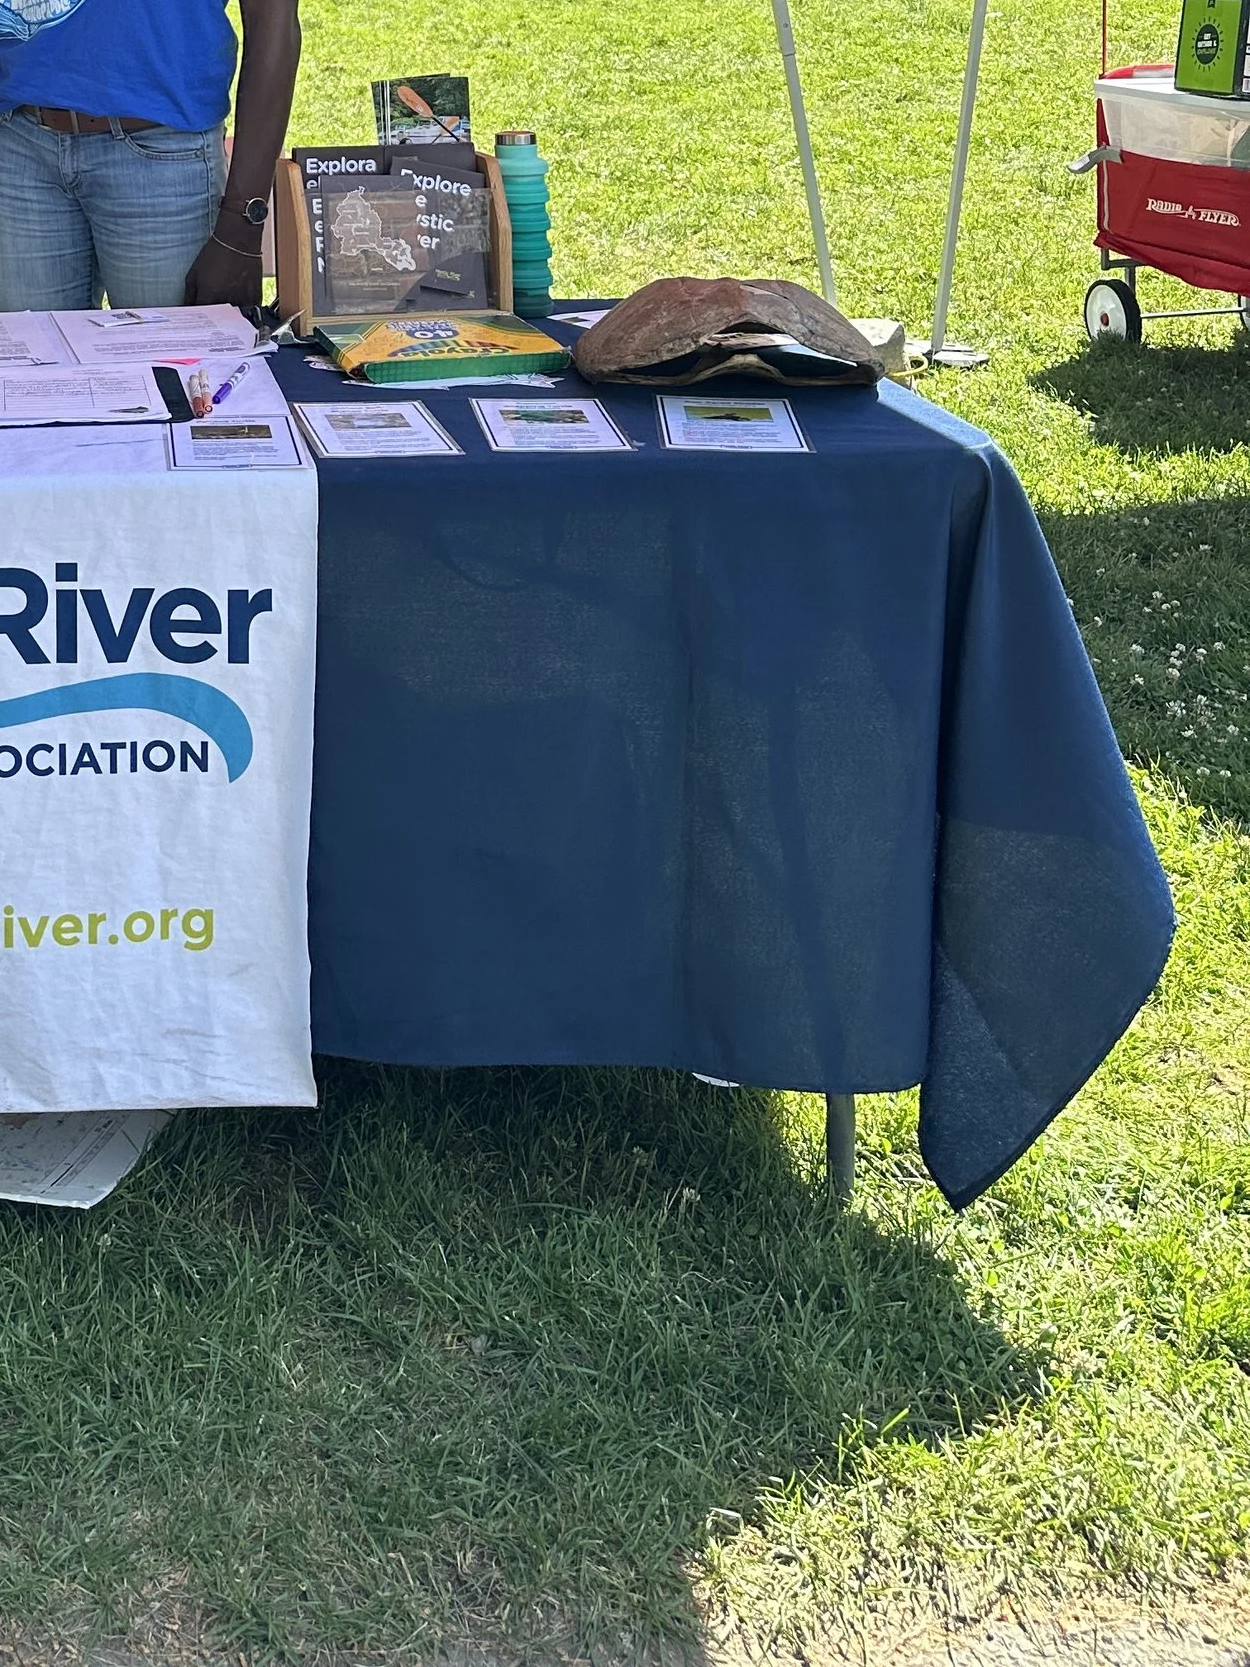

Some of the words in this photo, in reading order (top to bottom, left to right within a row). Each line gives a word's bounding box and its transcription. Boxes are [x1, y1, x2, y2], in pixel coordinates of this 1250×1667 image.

[306, 157, 377, 176] Explora
[1146, 198, 1183, 213] RADIO
[1197, 210, 1240, 226] FLYER
[417, 213, 454, 232] stic
[414, 329, 454, 339] 40
[401, 344, 510, 358] Crayola
